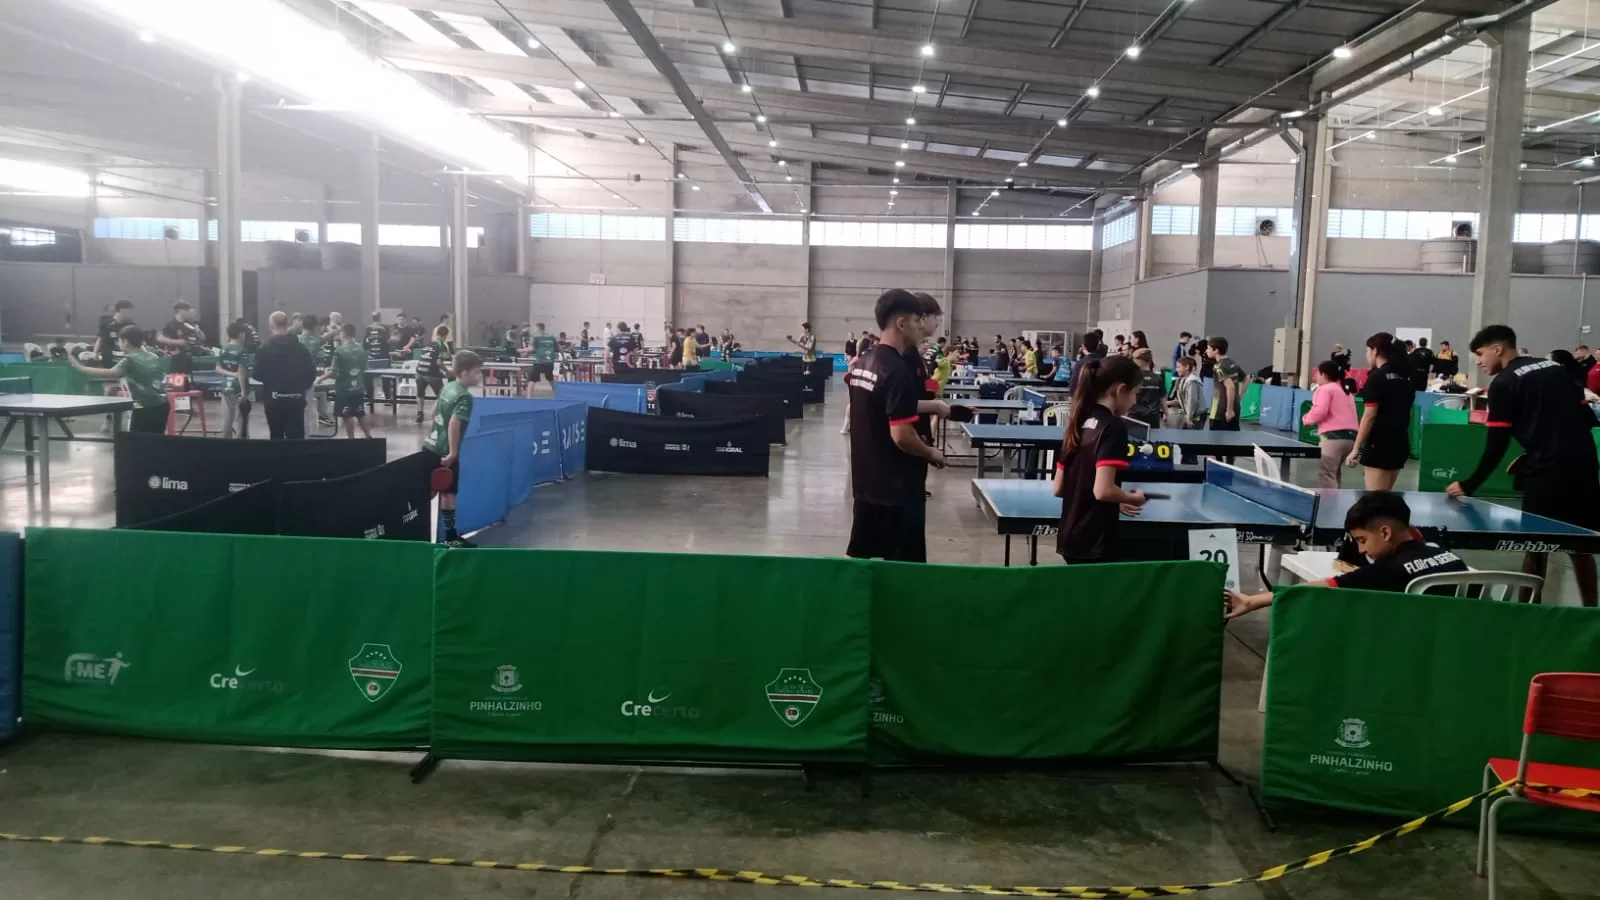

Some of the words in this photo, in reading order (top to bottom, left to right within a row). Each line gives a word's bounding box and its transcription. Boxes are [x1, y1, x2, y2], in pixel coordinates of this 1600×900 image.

[162, 477, 188, 490] lima
[1495, 540, 1561, 553] Hobby
[1199, 549, 1229, 564] 20
[469, 701, 543, 711] PINHALZINHO
[1309, 753, 1394, 772] PINHALZINHO
